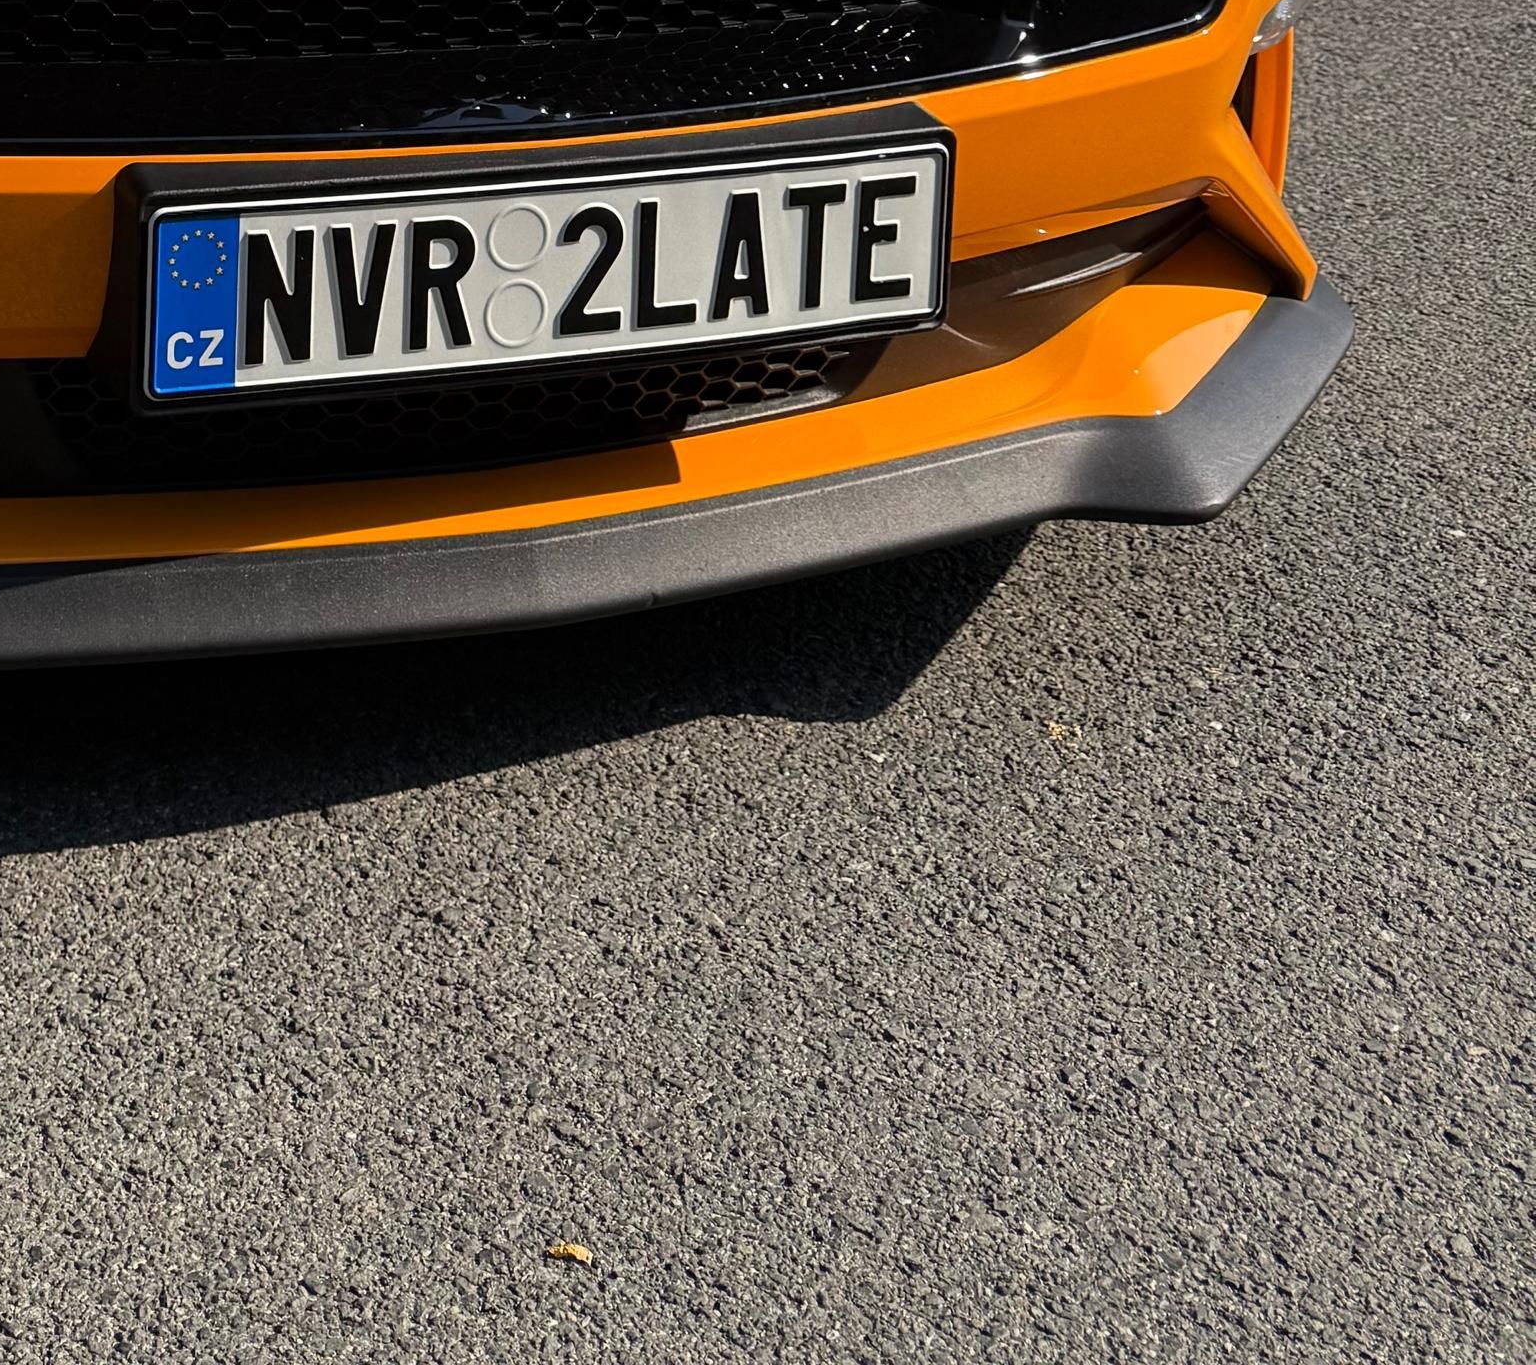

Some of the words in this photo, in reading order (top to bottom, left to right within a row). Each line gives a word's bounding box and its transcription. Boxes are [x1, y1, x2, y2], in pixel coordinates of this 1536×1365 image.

[243, 218, 477, 367] NVR
[558, 174, 918, 338] 2LATE
[164, 327, 226, 370] CZ
